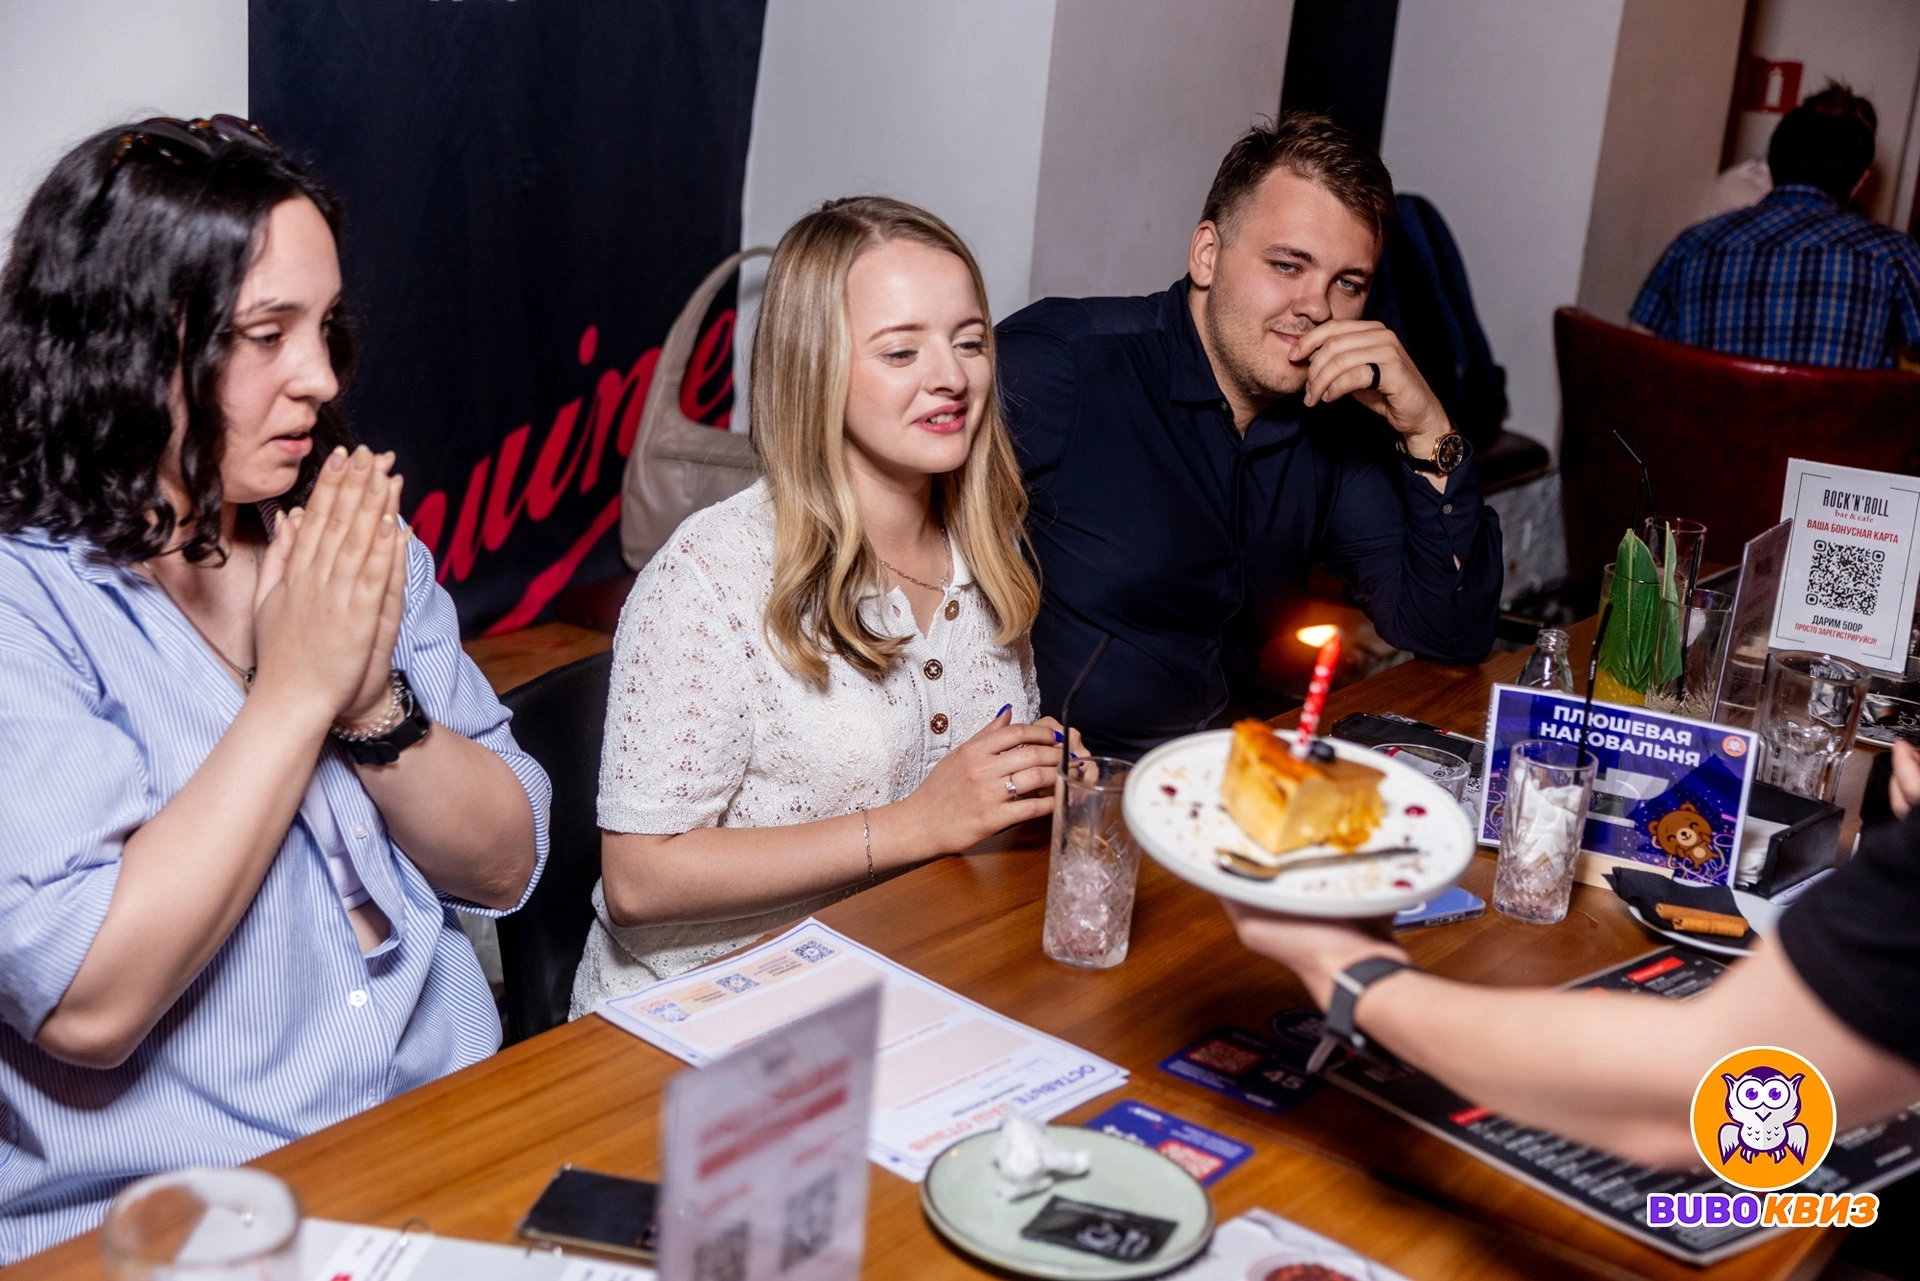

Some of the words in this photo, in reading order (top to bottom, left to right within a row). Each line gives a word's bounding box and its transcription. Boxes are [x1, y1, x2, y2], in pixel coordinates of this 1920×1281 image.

[1822, 489, 1889, 517] ROCK'N'ROLL
[1834, 509, 1848, 519] bar
[1857, 514, 1875, 524] cafe
[1806, 518, 1829, 531] ВАША
[1830, 523, 1872, 539] БОНУСНАЯ
[1873, 531, 1899, 544] КАРТА
[1794, 622, 1818, 634] ПРОСТО
[1818, 627, 1878, 646] ЗАРЕГИСТРИРУЙСЯ!
[1811, 614, 1841, 629] ДАРИМ
[1553, 705, 1692, 747] ПЛЮШЕВАЯ
